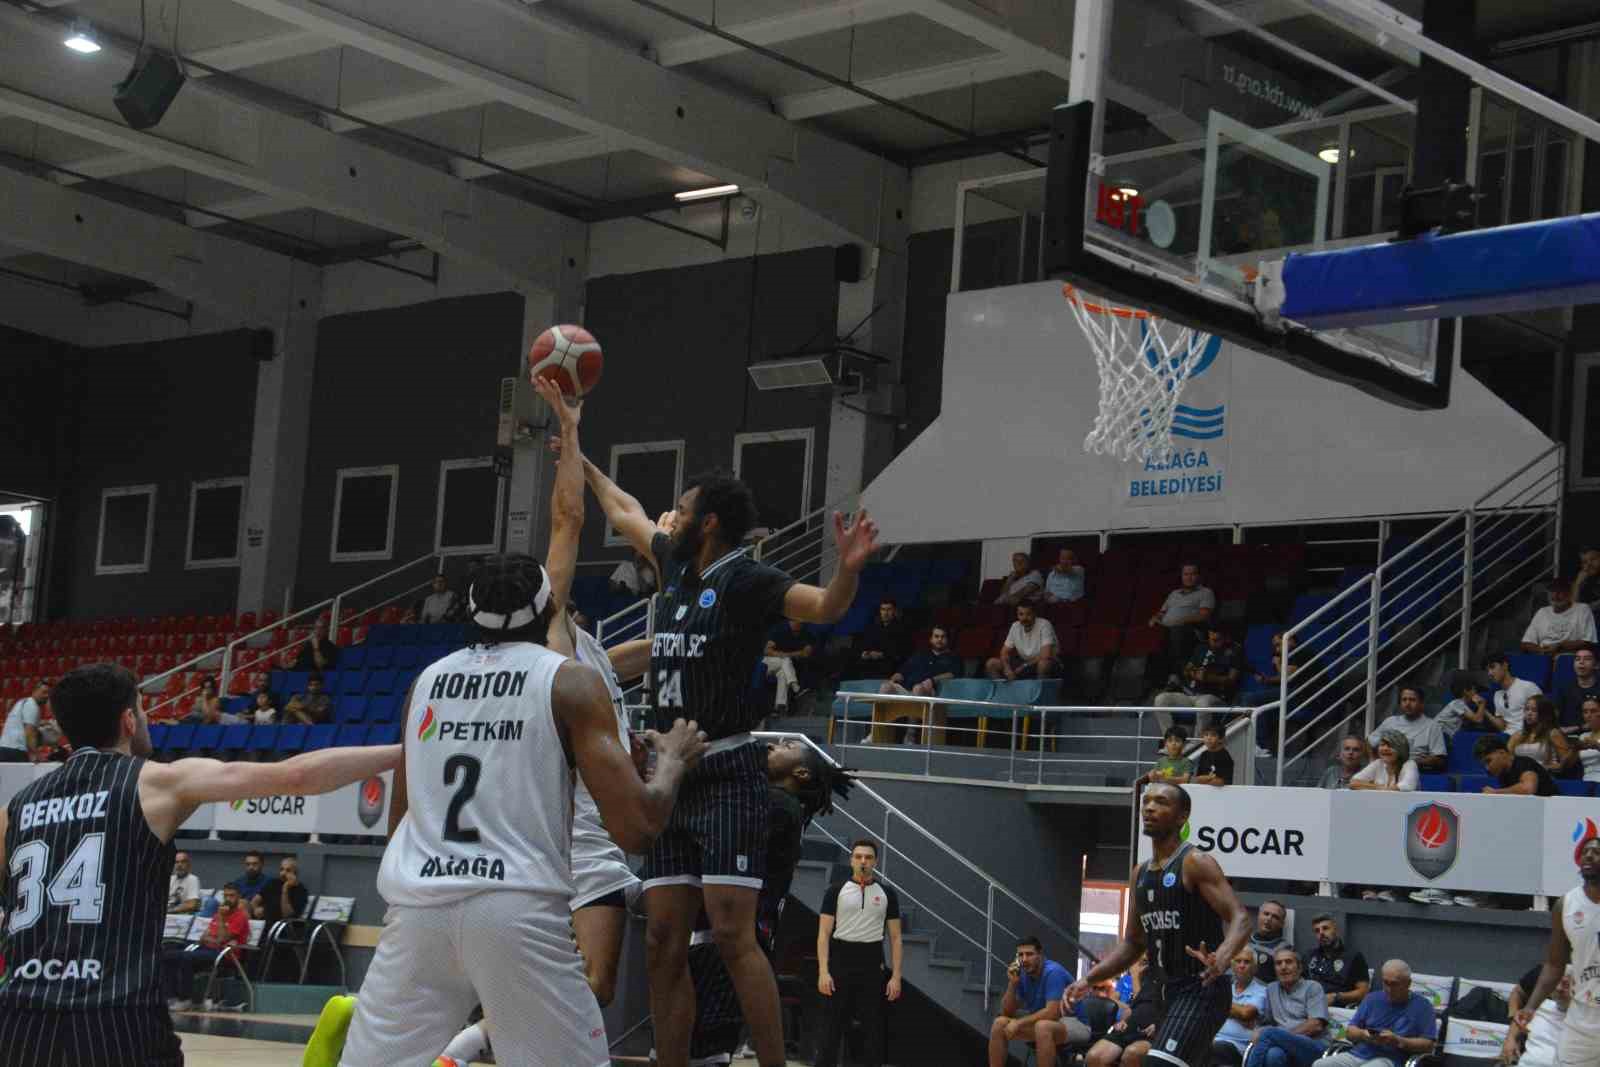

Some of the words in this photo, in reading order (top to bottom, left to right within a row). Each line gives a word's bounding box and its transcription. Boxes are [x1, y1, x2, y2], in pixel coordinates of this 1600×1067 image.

[1144, 448, 1209, 471] AAĞA
[1129, 470, 1222, 497] BELEDİYESİ
[429, 670, 528, 700] HORTON
[20, 791, 109, 831] BERKOZ
[247, 796, 305, 815] SOCAR
[442, 753, 482, 844] 2
[1197, 826, 1304, 856] SOCAR
[8, 832, 106, 935] 34
